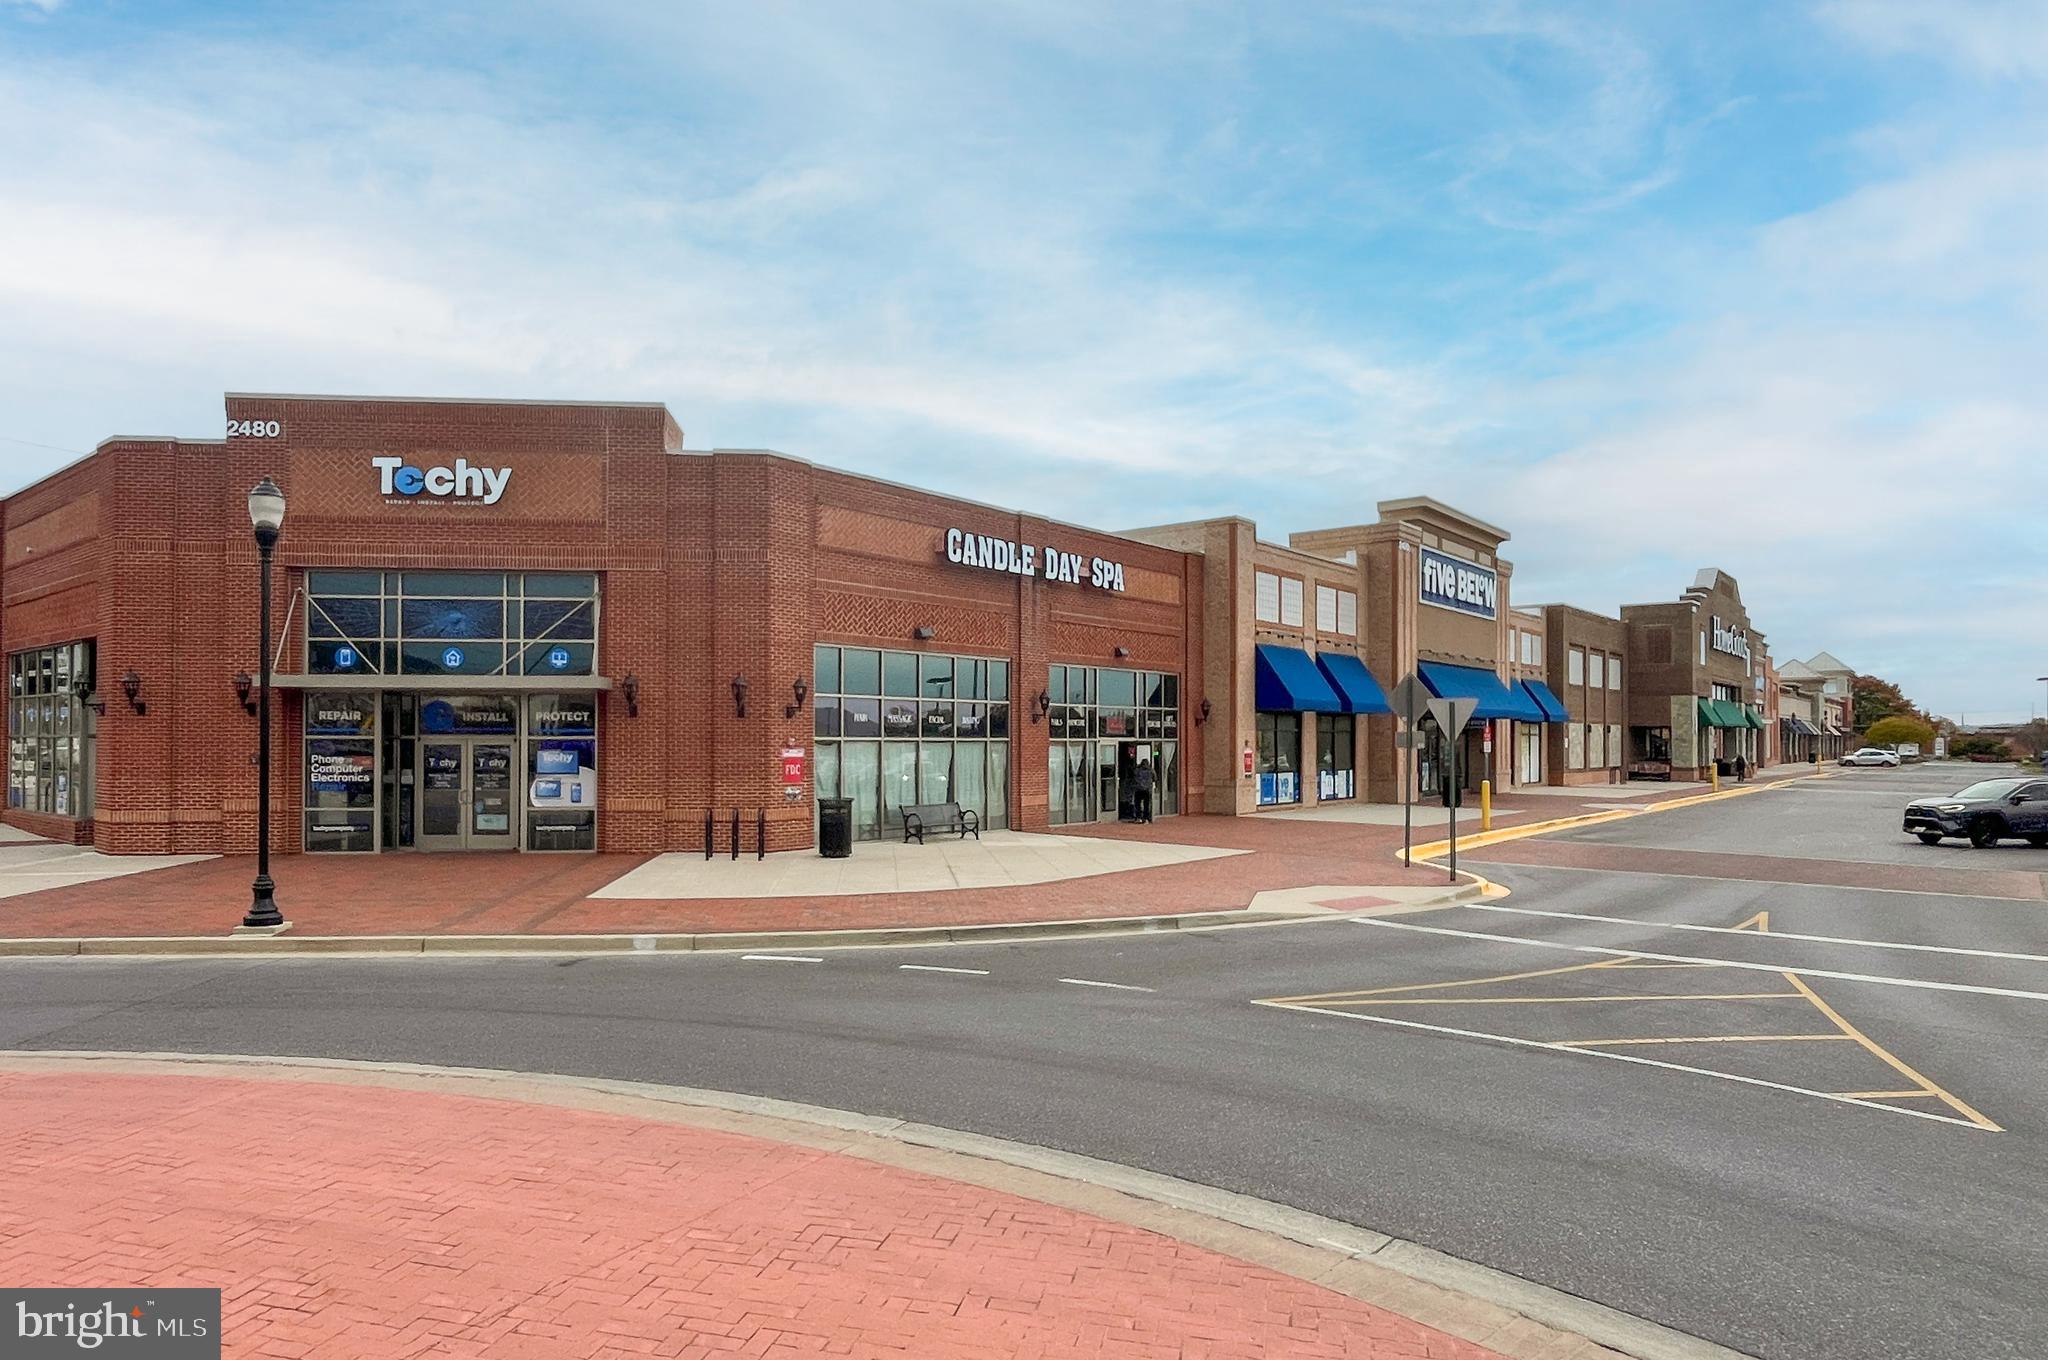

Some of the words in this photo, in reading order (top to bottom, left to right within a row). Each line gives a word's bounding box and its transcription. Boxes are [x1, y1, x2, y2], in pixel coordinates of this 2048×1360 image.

[227, 420, 281, 438] 2480
[371, 456, 512, 506] Techy
[946, 527, 1036, 577] CANDLE
[1043, 546, 1085, 585] DAY
[1091, 556, 1126, 592] SPA
[318, 710, 362, 722] REPAIR
[462, 711, 509, 722] INSTALL
[535, 711, 590, 722] PROTECT
[311, 755, 345, 766] Phone
[311, 764, 363, 775] Computer
[785, 764, 801, 775] FDC
[311, 773, 370, 782] Electronics
